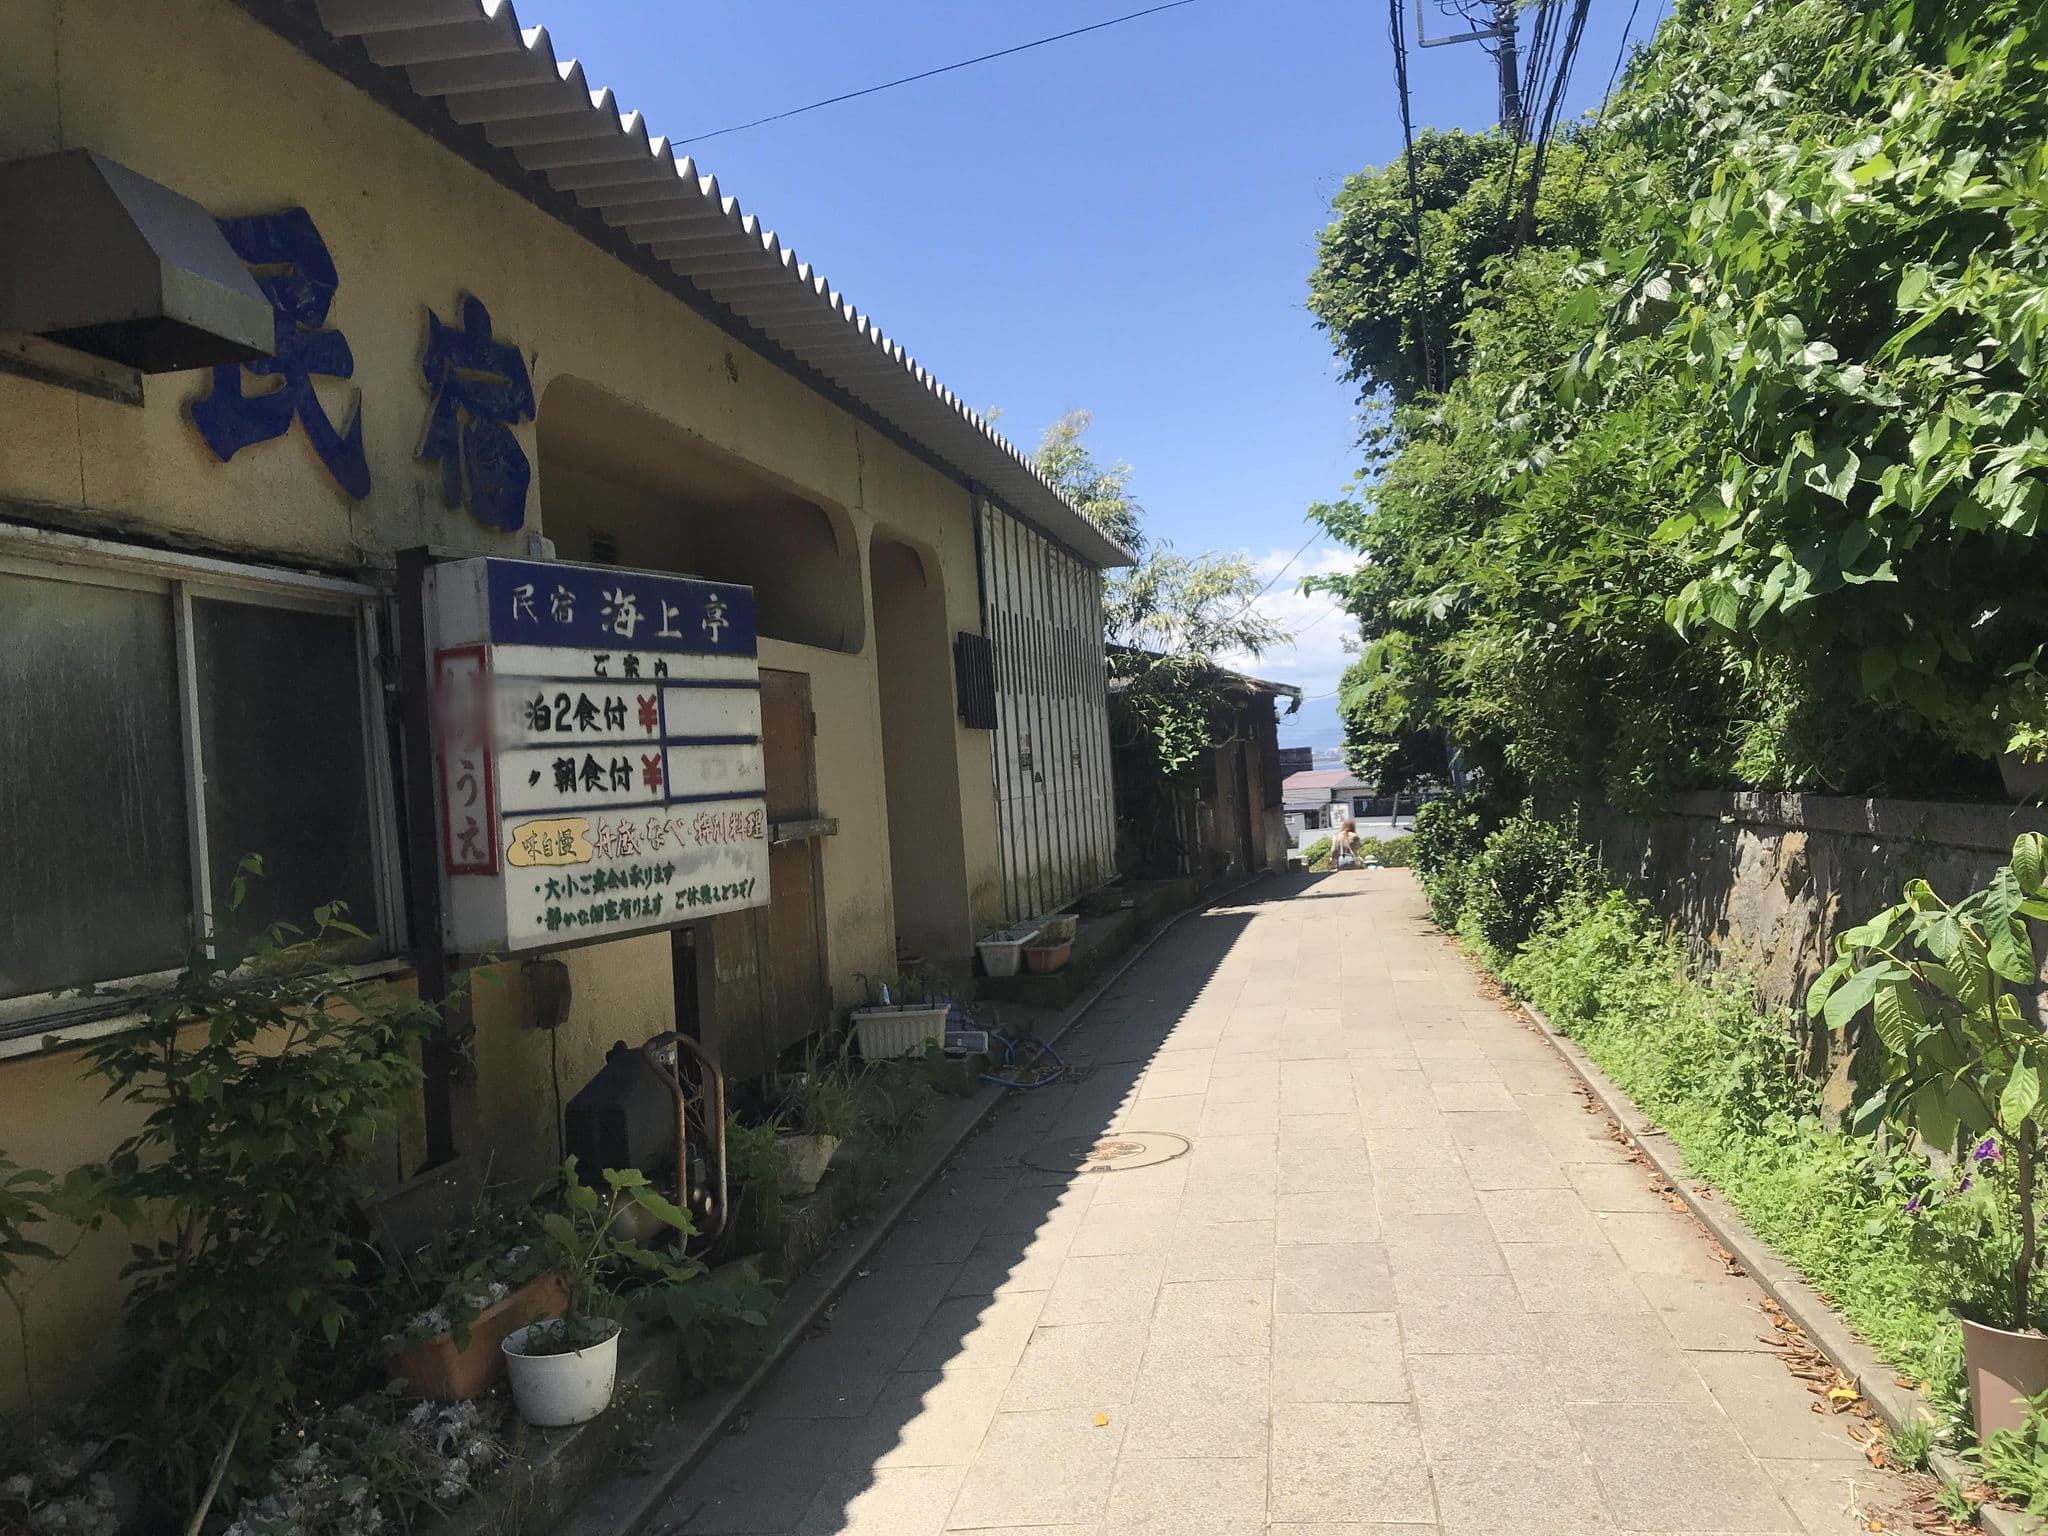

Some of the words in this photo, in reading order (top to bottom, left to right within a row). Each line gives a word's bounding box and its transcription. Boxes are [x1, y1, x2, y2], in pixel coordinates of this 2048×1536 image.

[191, 206, 537, 532] 民宿
[512, 583, 577, 623] 民宿
[600, 587, 730, 643] 海上亭
[593, 654, 668, 678] ご案内
[508, 691, 628, 733] 泊2食付
[522, 829, 578, 860] 味自慢
